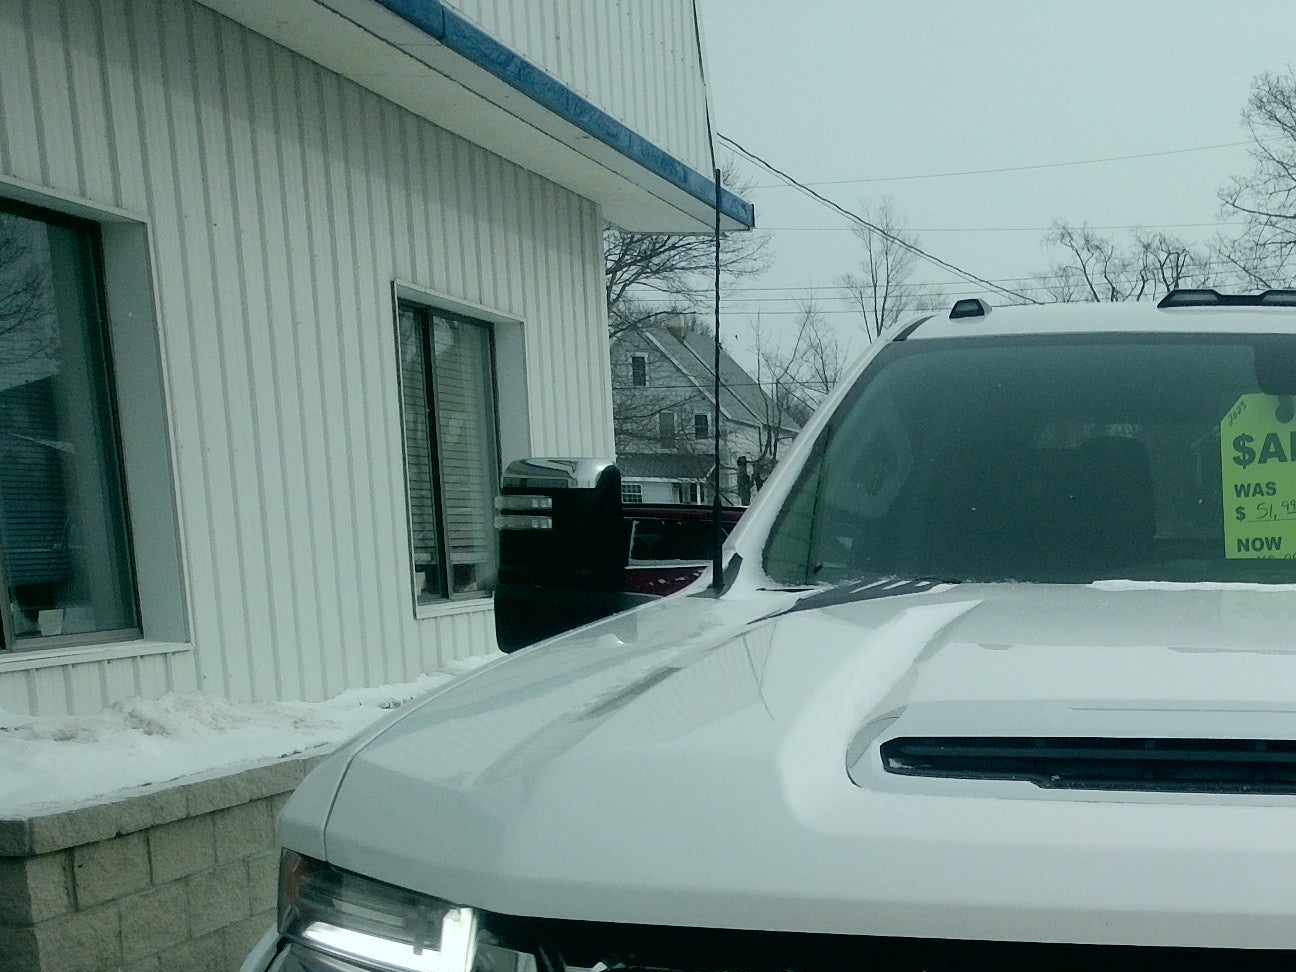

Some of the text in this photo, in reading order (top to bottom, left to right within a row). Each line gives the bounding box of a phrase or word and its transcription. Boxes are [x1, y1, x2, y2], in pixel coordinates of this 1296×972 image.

[1233, 481, 1277, 498] WAS
[1235, 505, 1246, 521] $
[1236, 536, 1282, 553] NOW
